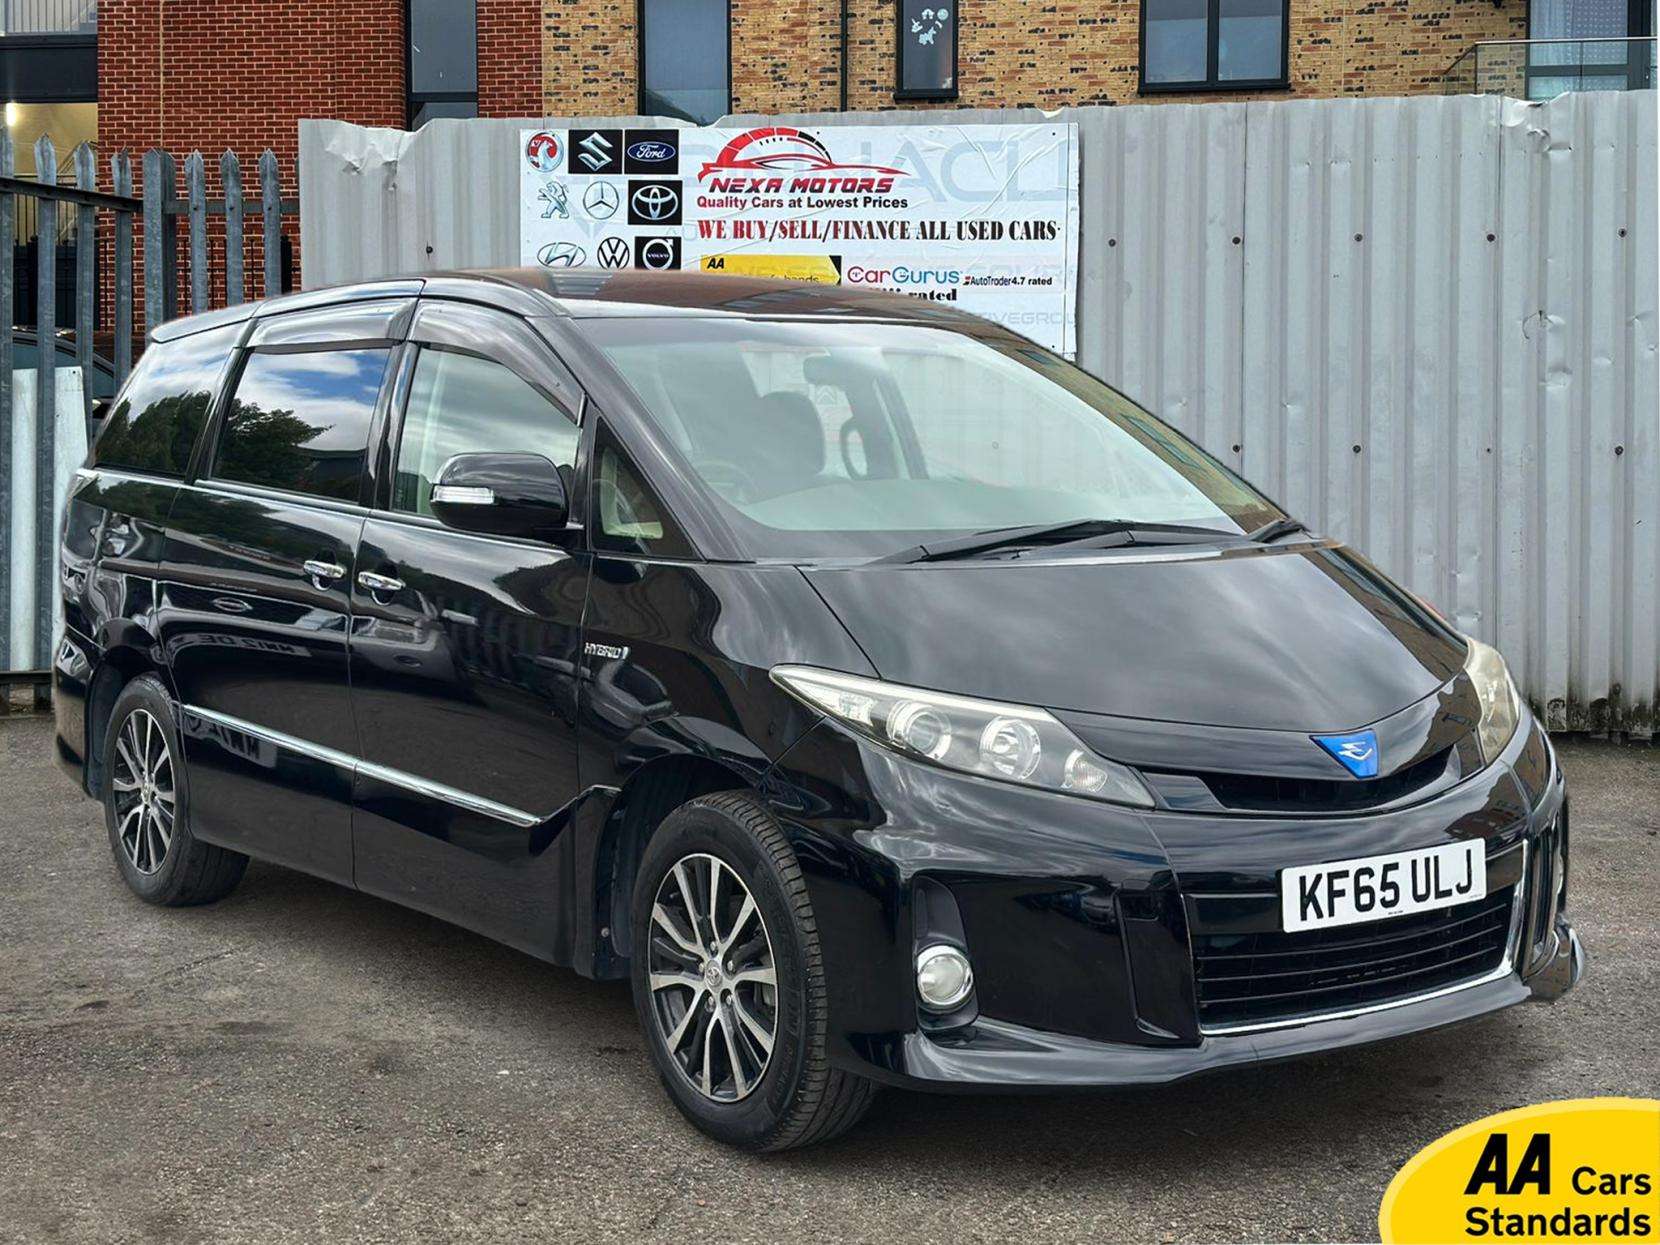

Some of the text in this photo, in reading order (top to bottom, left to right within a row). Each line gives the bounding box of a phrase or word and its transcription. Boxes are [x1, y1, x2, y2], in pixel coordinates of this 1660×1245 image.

[636, 144, 666, 159] Ford
[709, 178, 895, 194] NEXA MOTORS
[696, 196, 908, 210] Quality Cars at Lowest Prices
[697, 220, 727, 240] WE
[916, 220, 951, 240] ALL
[956, 221, 1004, 241] USED
[706, 257, 725, 269] AA
[847, 266, 960, 284] CarGurus
[1028, 277, 1053, 286] rated
[1299, 848, 1473, 922] KF65 ULJ
